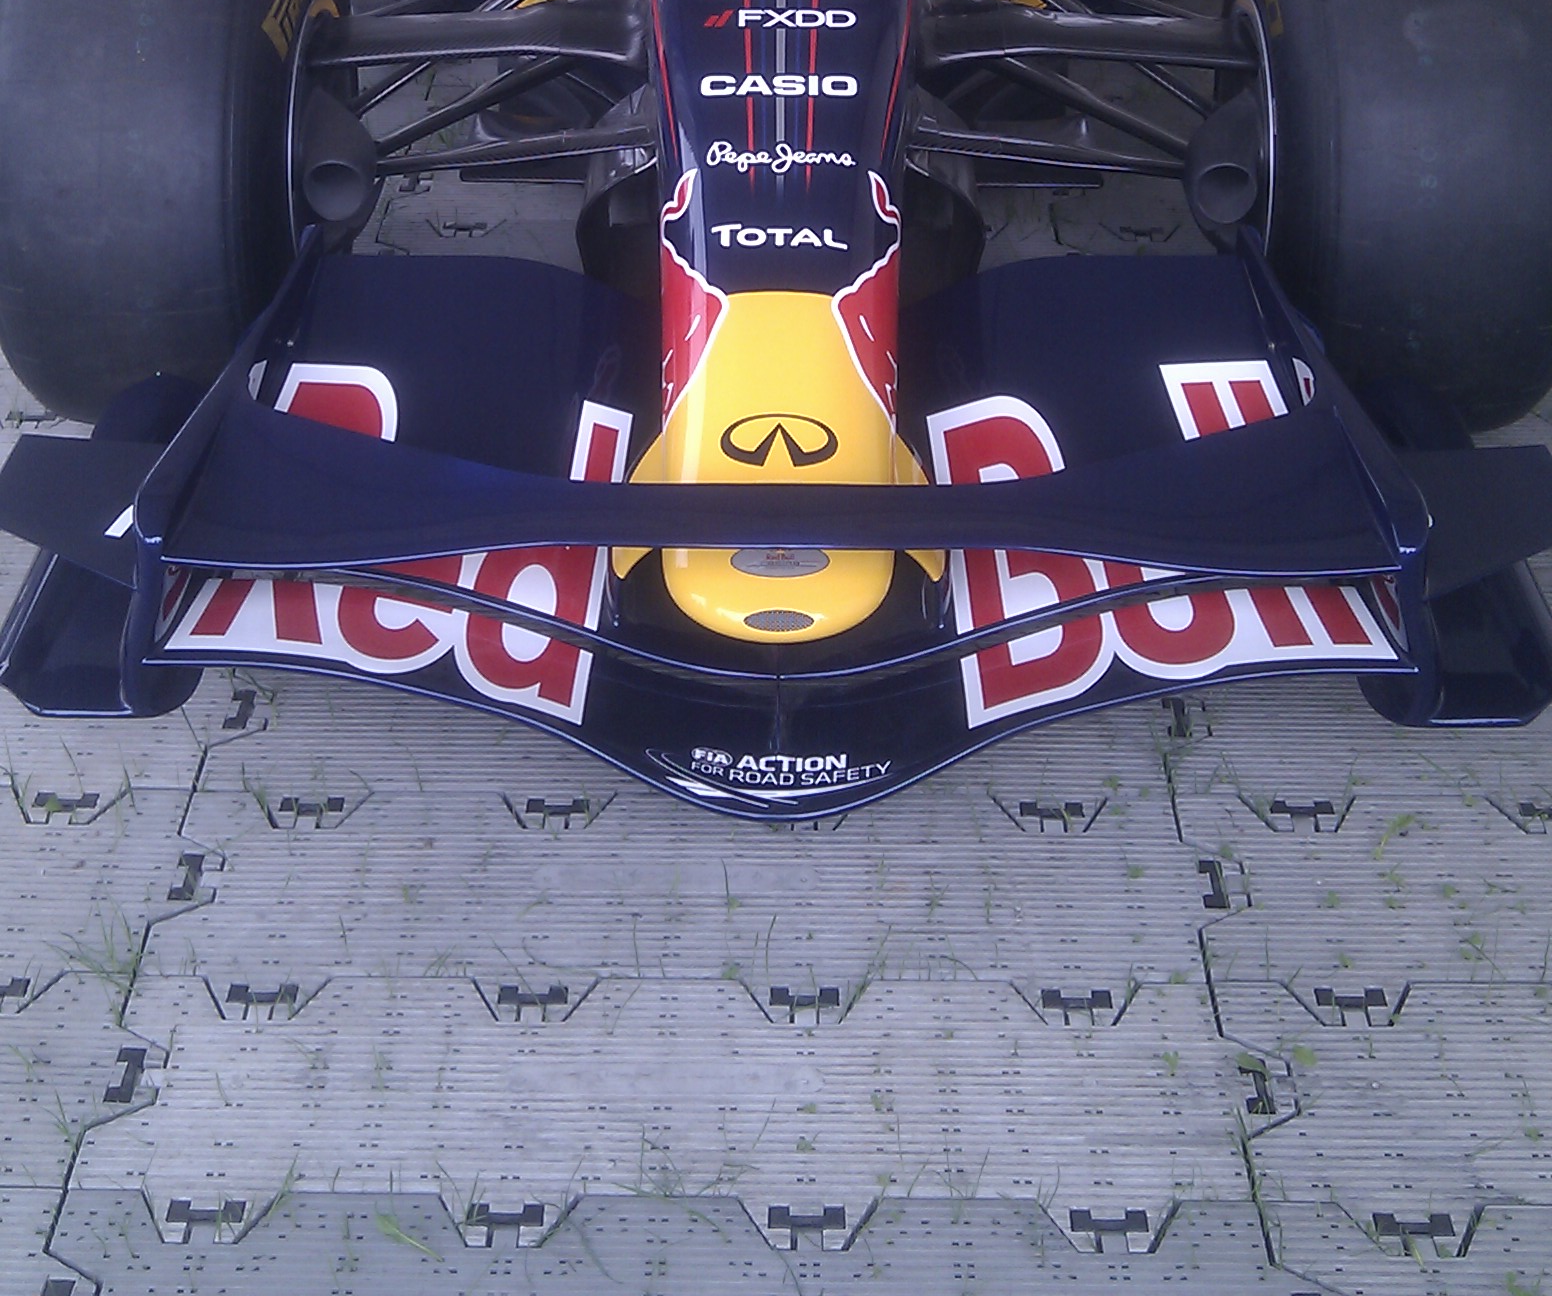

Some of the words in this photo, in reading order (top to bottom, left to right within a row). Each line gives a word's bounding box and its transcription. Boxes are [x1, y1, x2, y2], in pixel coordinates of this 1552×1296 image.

[738, 9, 857, 28] FXDD
[700, 75, 858, 97] CASIO
[706, 140, 772, 172] Pepe
[770, 143, 857, 174] Jeans
[694, 749, 729, 764] FIA
[736, 754, 847, 772] ACTION
[691, 761, 724, 777] FOR
[728, 768, 795, 785] ROAD
[799, 760, 892, 785] SAFETY
